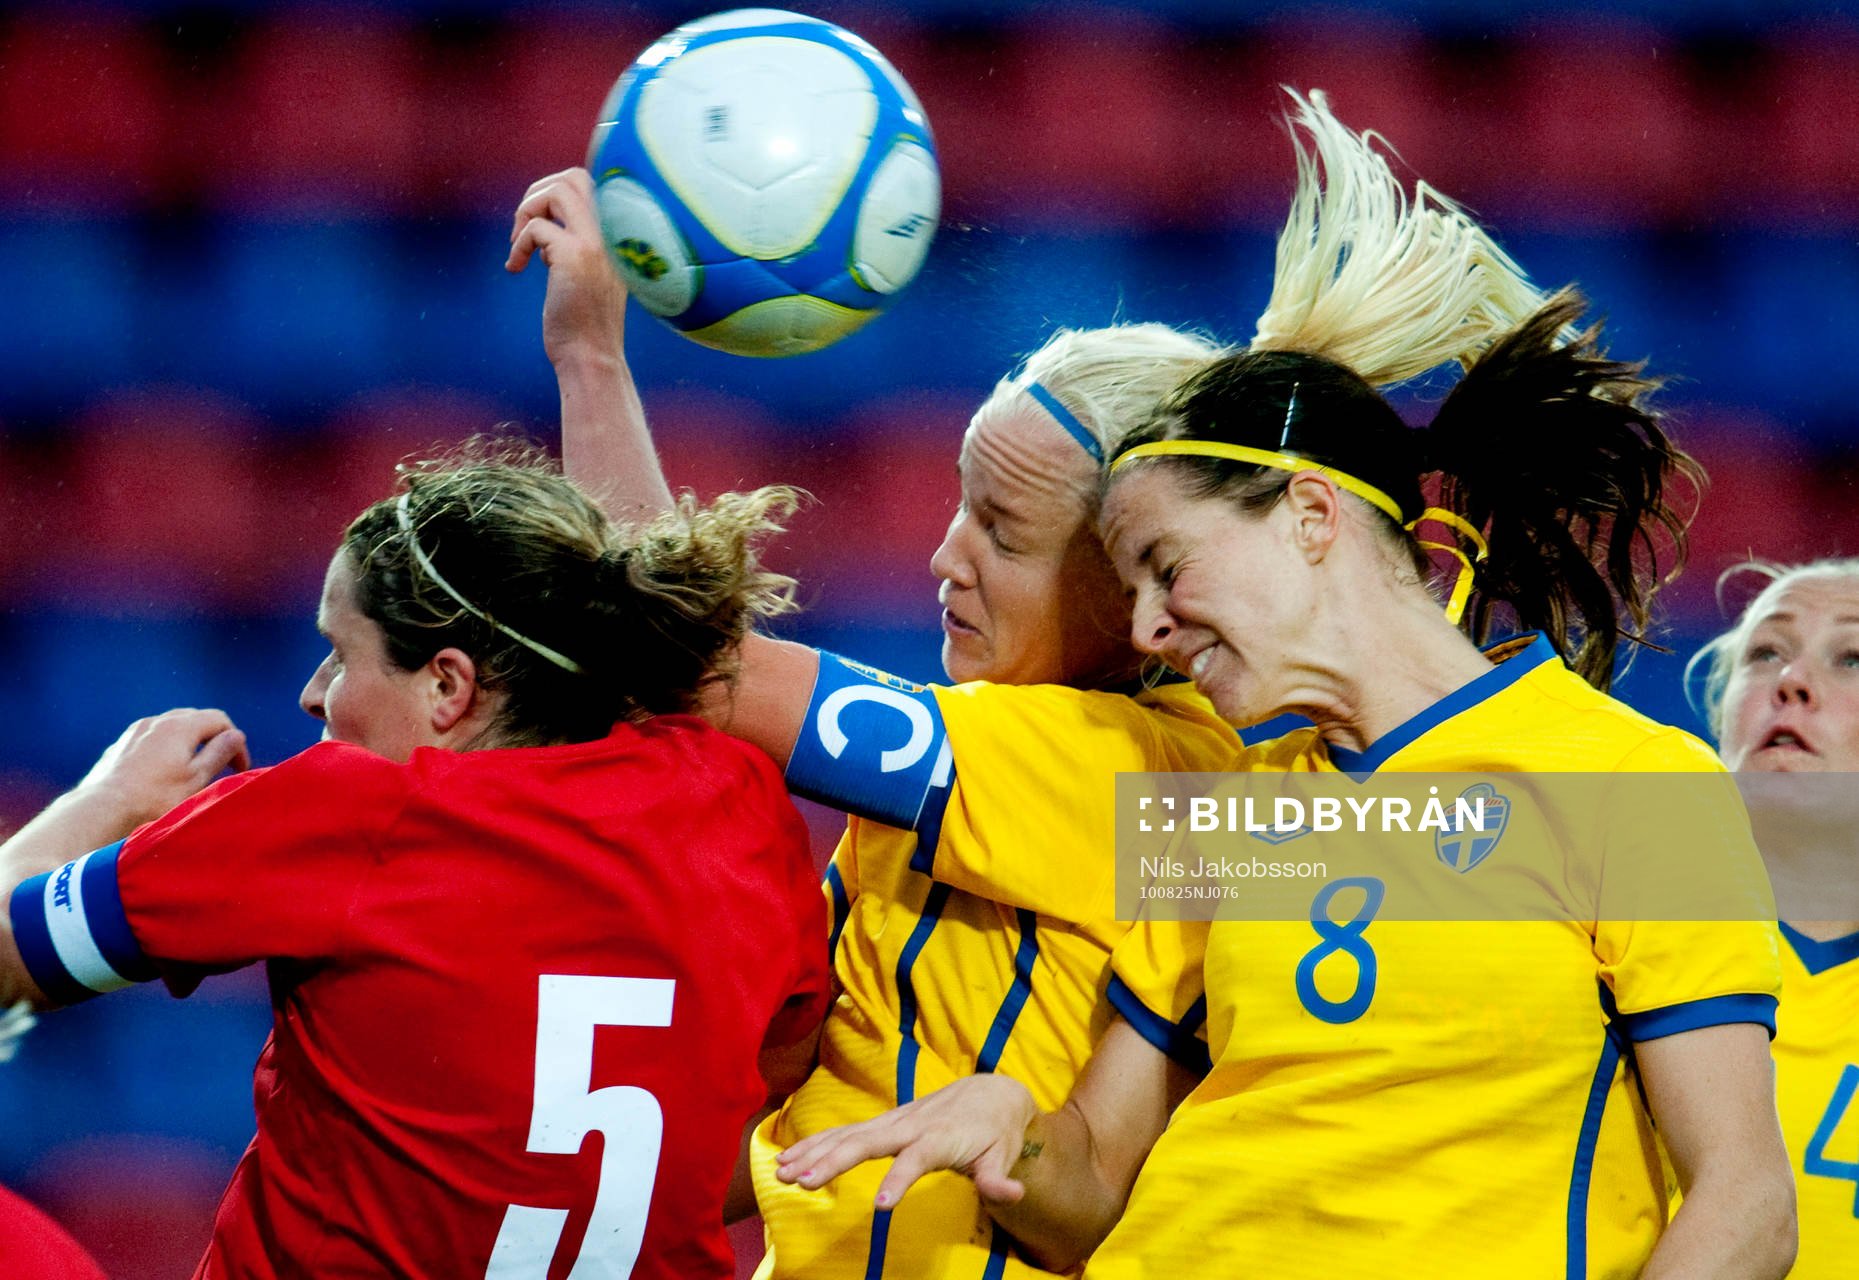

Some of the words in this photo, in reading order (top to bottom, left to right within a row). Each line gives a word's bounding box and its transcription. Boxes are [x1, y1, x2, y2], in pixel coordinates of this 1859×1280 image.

[816, 684, 934, 773] C
[1295, 876, 1385, 1025] 8
[484, 974, 676, 1280] 5
[1803, 1063, 1859, 1219] 4
